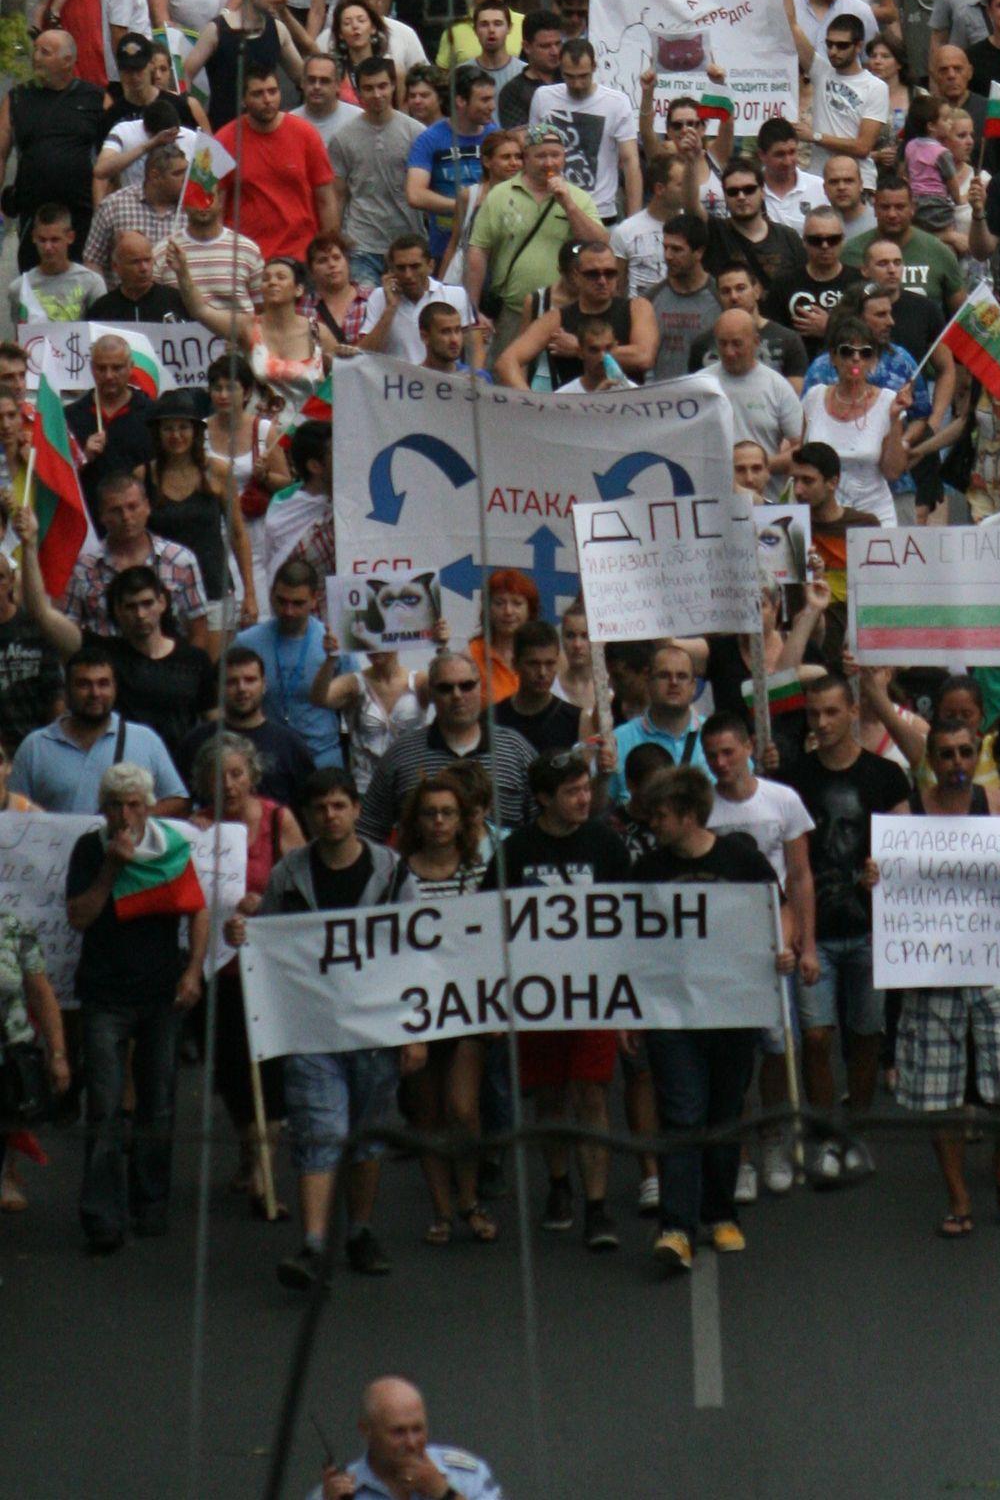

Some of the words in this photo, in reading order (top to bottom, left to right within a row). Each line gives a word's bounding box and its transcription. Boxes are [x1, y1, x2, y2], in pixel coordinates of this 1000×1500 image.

[728, 0, 755, 26] ДПС
[673, 79, 694, 91] ПЪТ
[743, 101, 761, 122] ОТ
[762, 100, 787, 121] НАС
[383, 374, 424, 401] Не
[435, 382, 453, 401] е
[486, 486, 578, 518] АТАКА
[582, 499, 724, 549] ДПС
[859, 534, 927, 569] ДА
[880, 856, 908, 882] ОТ
[318, 906, 443, 975] ДПС
[506, 892, 709, 946] ИЗВЪН
[882, 911, 991, 934] НАЗНАЧЕН
[884, 939, 953, 966] СРАМ
[399, 972, 644, 1036] ЗАКОНА
